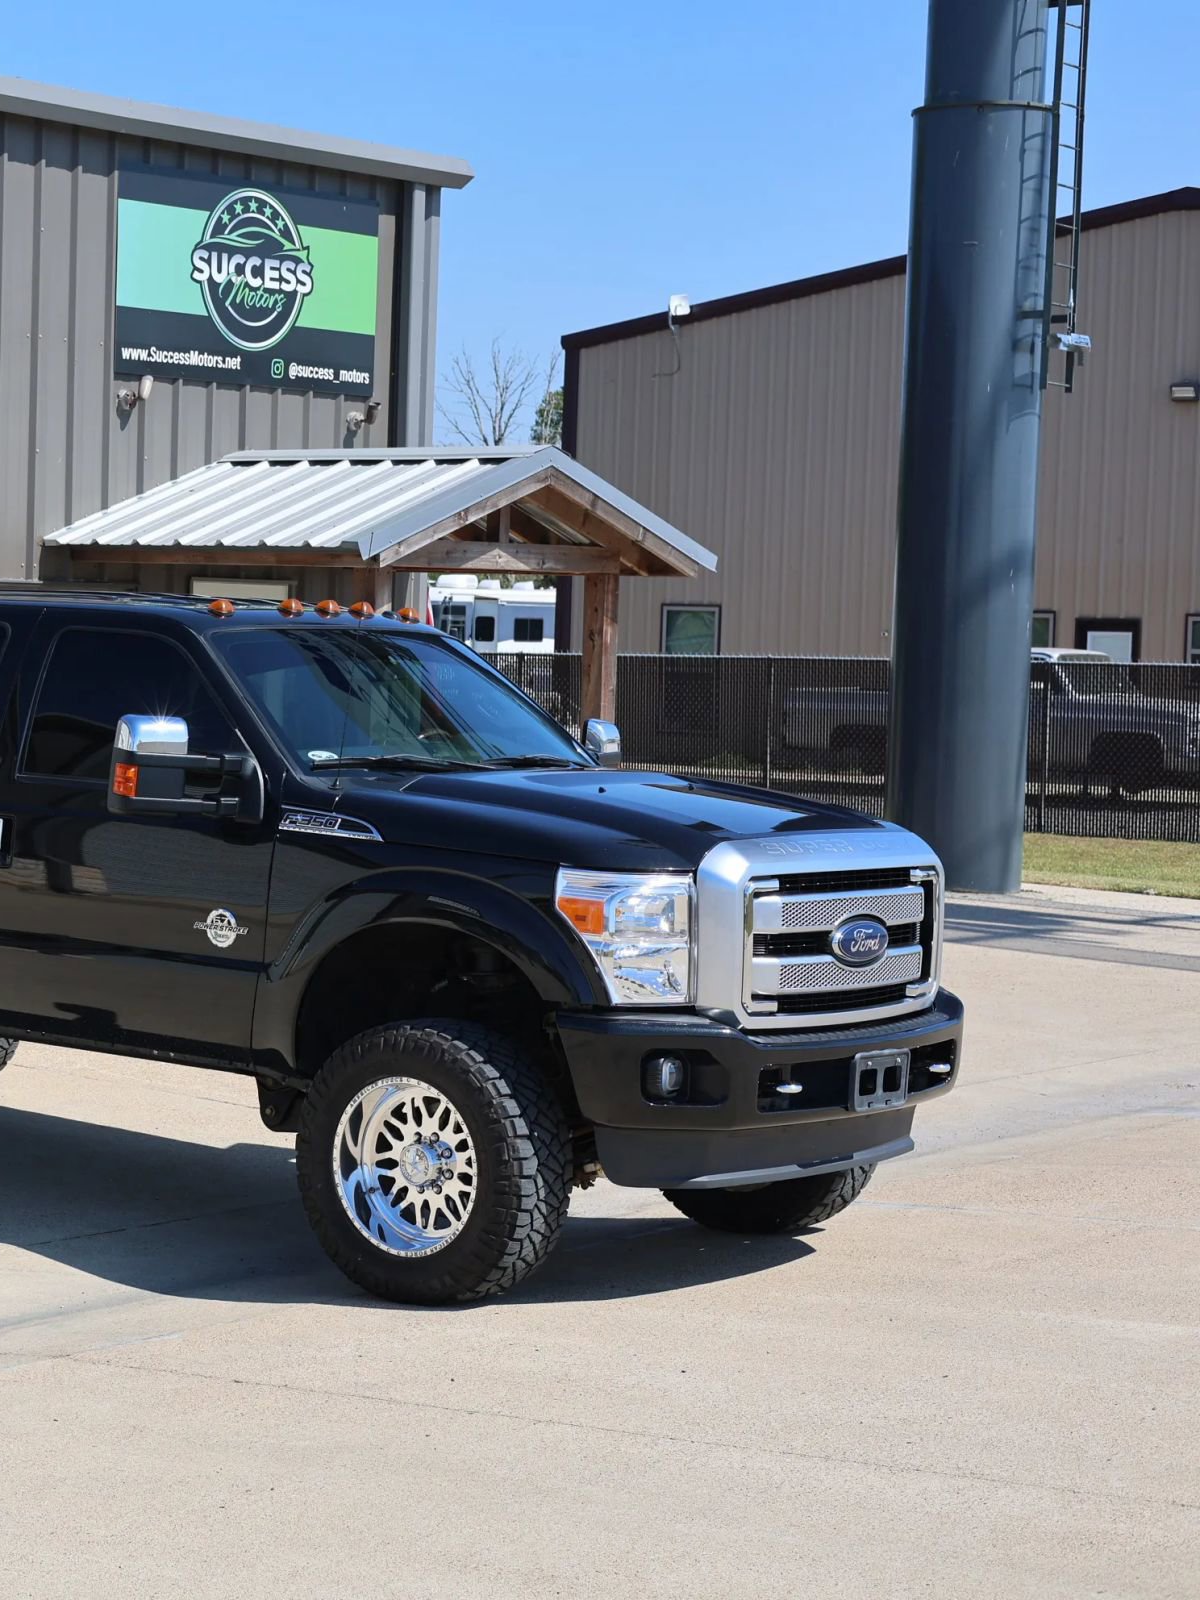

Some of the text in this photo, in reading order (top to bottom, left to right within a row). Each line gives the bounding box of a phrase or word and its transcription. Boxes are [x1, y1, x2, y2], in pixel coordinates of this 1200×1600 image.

[192, 249, 313, 294] SUCCESS
[218, 271, 287, 312] Motors
[121, 346, 242, 370] www.SuccessMotors.net
[288, 362, 370, 384] @success_motors
[850, 928, 881, 952] Ford
